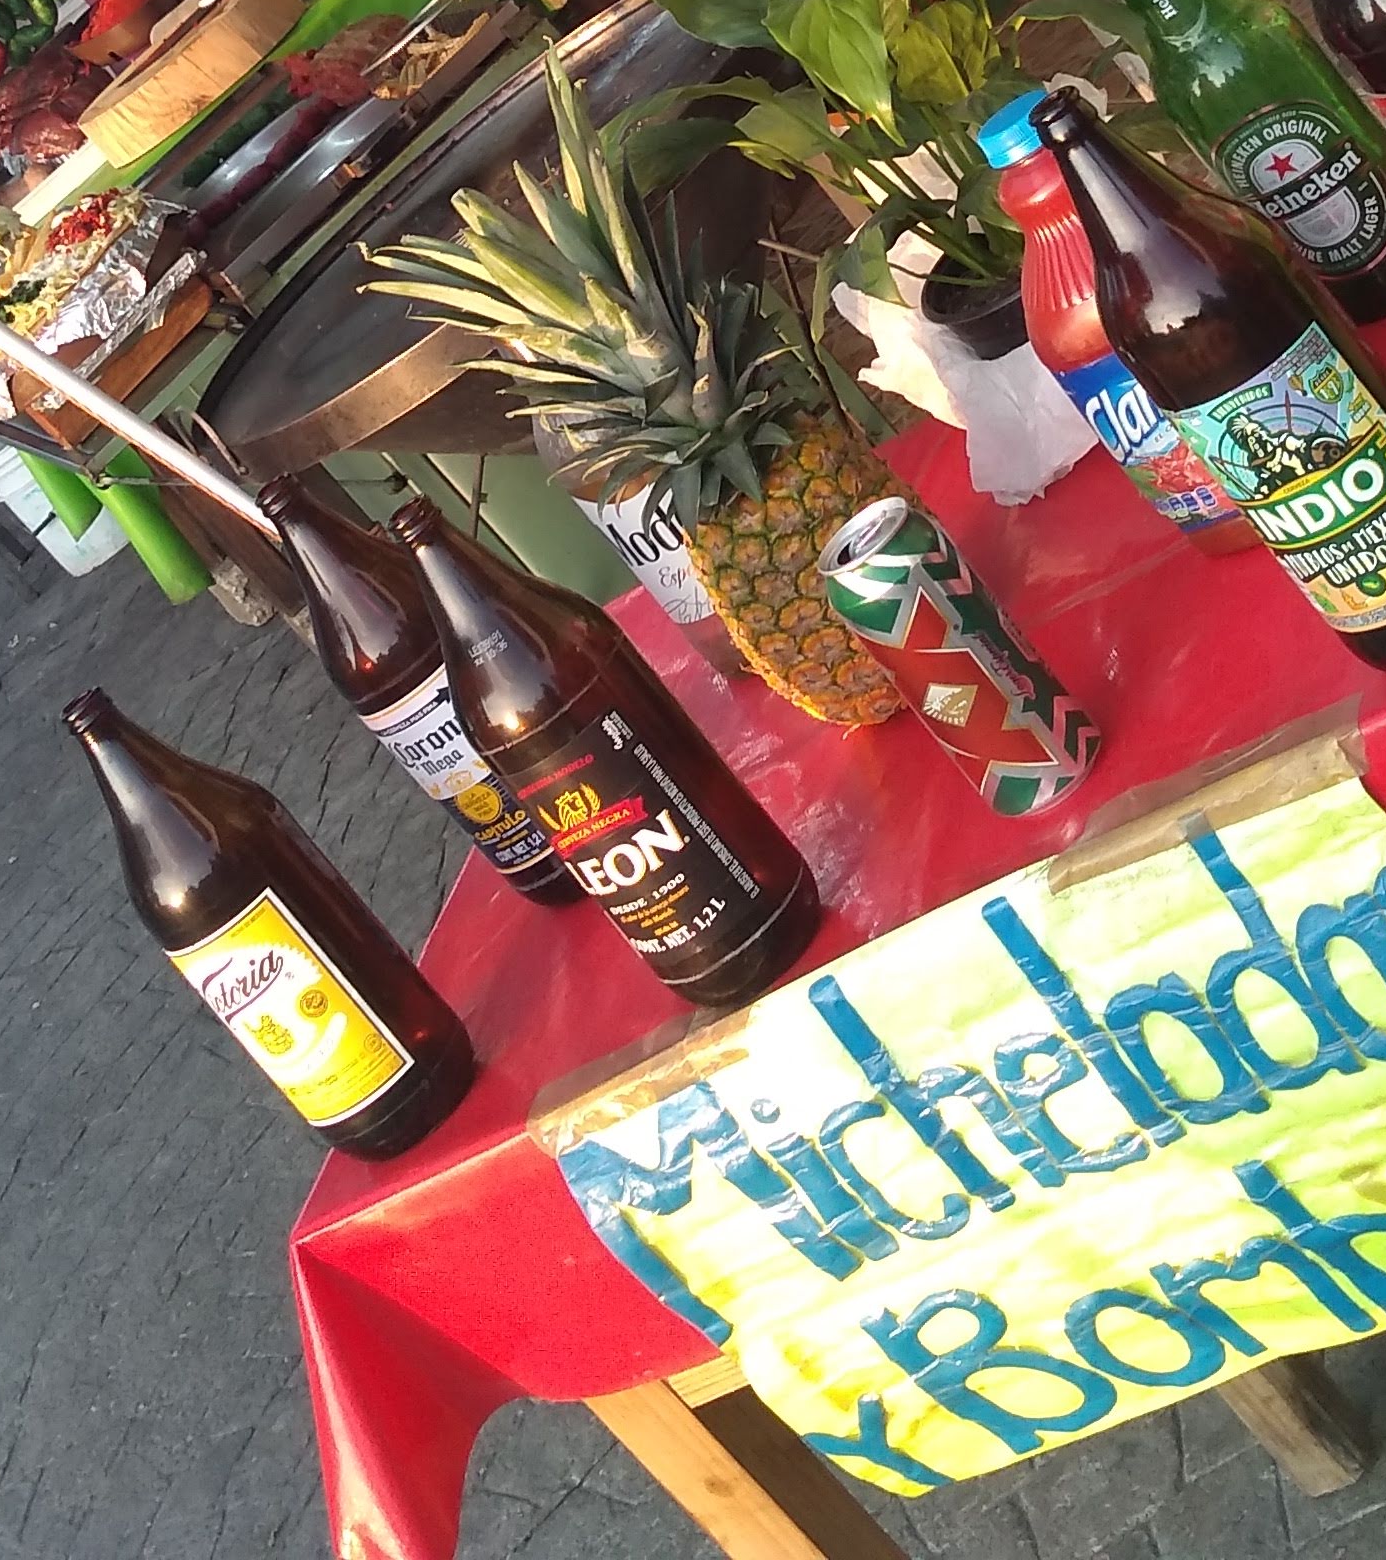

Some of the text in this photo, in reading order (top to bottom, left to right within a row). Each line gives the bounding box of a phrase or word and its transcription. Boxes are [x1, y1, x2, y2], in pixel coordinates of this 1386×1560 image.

[1232, 135, 1263, 189] HEINEKEN
[1263, 119, 1328, 145] ORIGINAL
[1328, 238, 1364, 263] MALT
[1363, 195, 1380, 240] LAGER
[1247, 458, 1385, 544] INDIO
[606, 504, 685, 567] Mod
[658, 566, 690, 589] Esp
[388, 717, 463, 768] Coron
[421, 749, 464, 777] Mega
[564, 808, 685, 896] LEON
[651, 872, 686, 899] 1900
[663, 924, 697, 952] NET.
[804, 1391, 942, 1492] Y
